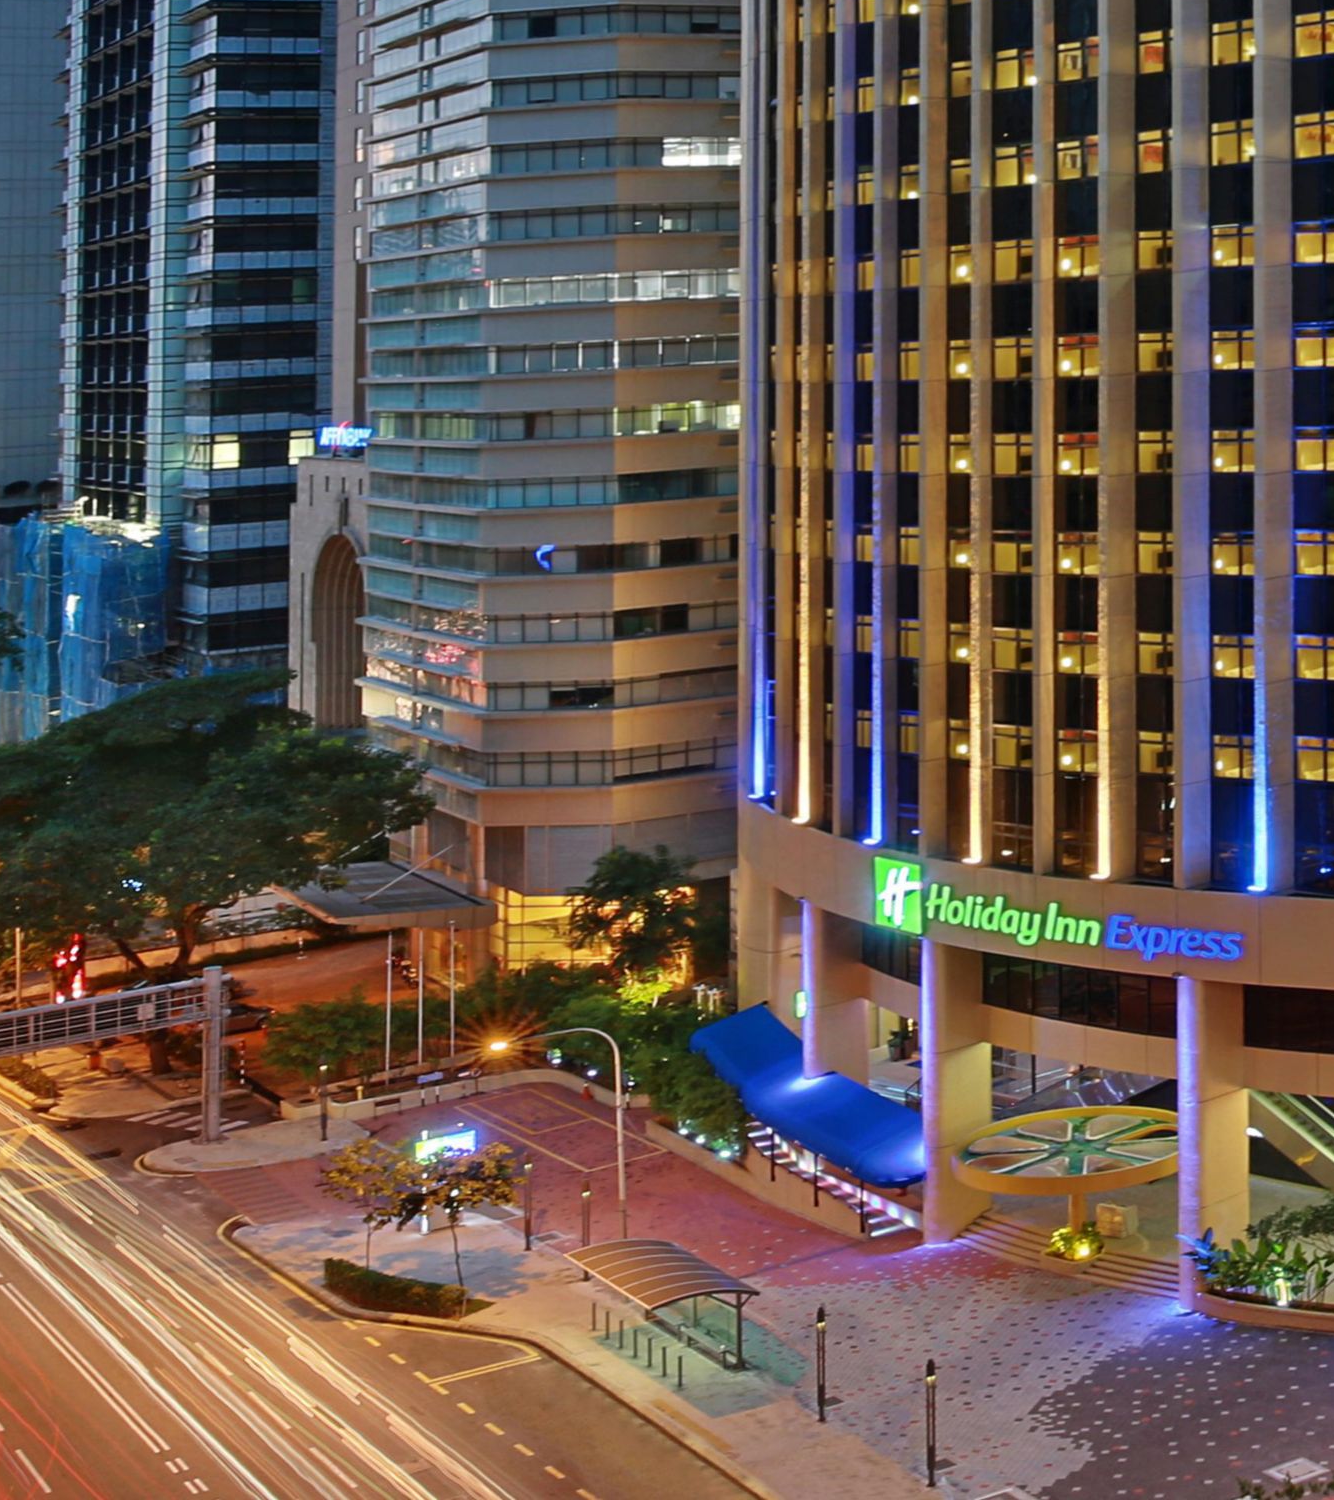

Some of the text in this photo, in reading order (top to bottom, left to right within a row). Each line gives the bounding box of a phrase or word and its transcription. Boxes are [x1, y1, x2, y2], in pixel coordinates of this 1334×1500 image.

[924, 883, 1245, 961] Holiday Inn Express
